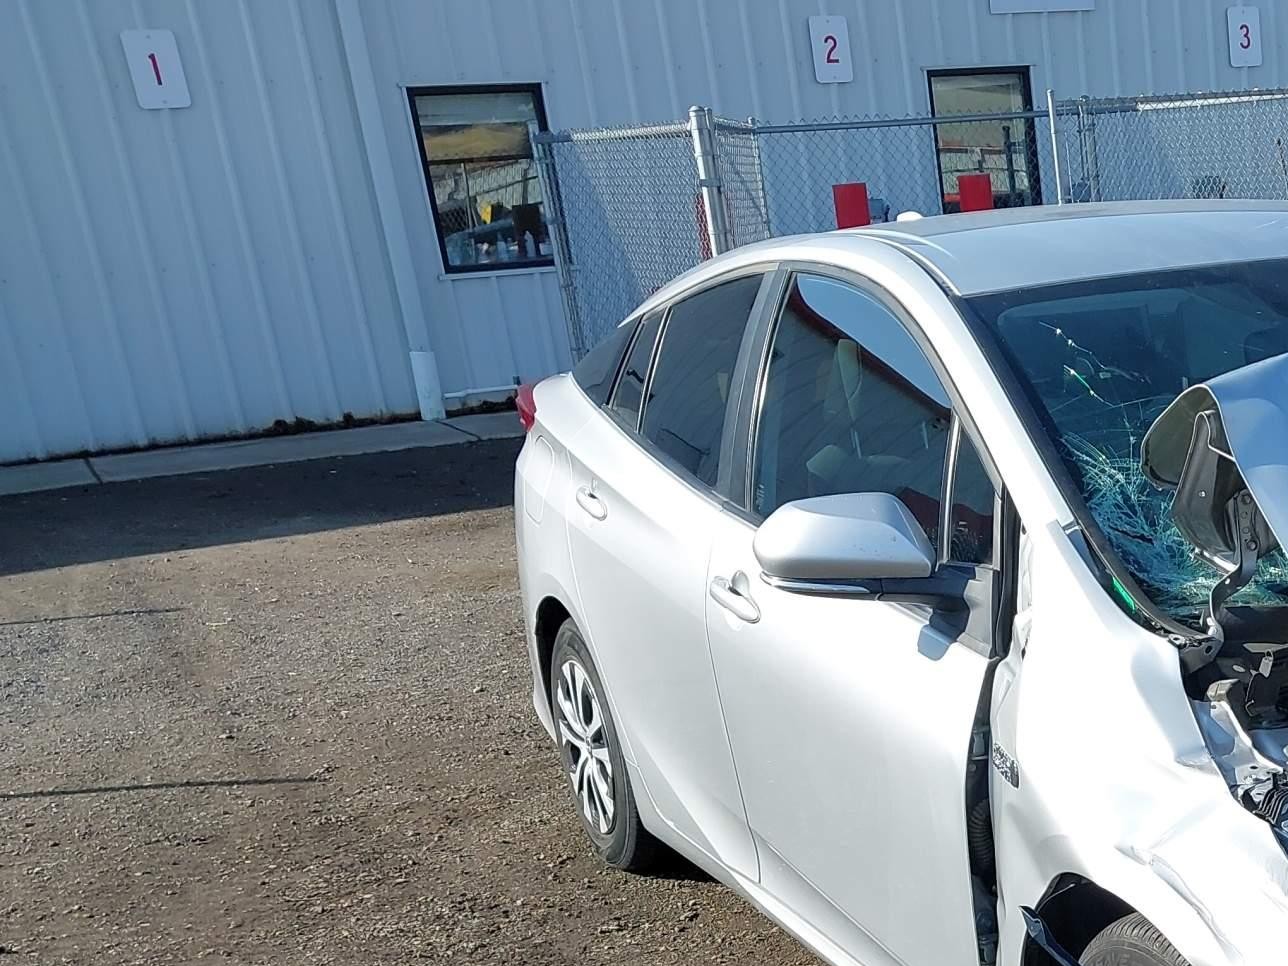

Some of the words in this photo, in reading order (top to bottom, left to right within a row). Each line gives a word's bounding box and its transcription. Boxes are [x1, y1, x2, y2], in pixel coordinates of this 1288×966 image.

[823, 35, 840, 64] 2
[1239, 24, 1251, 49] 3
[148, 53, 163, 86] 1
